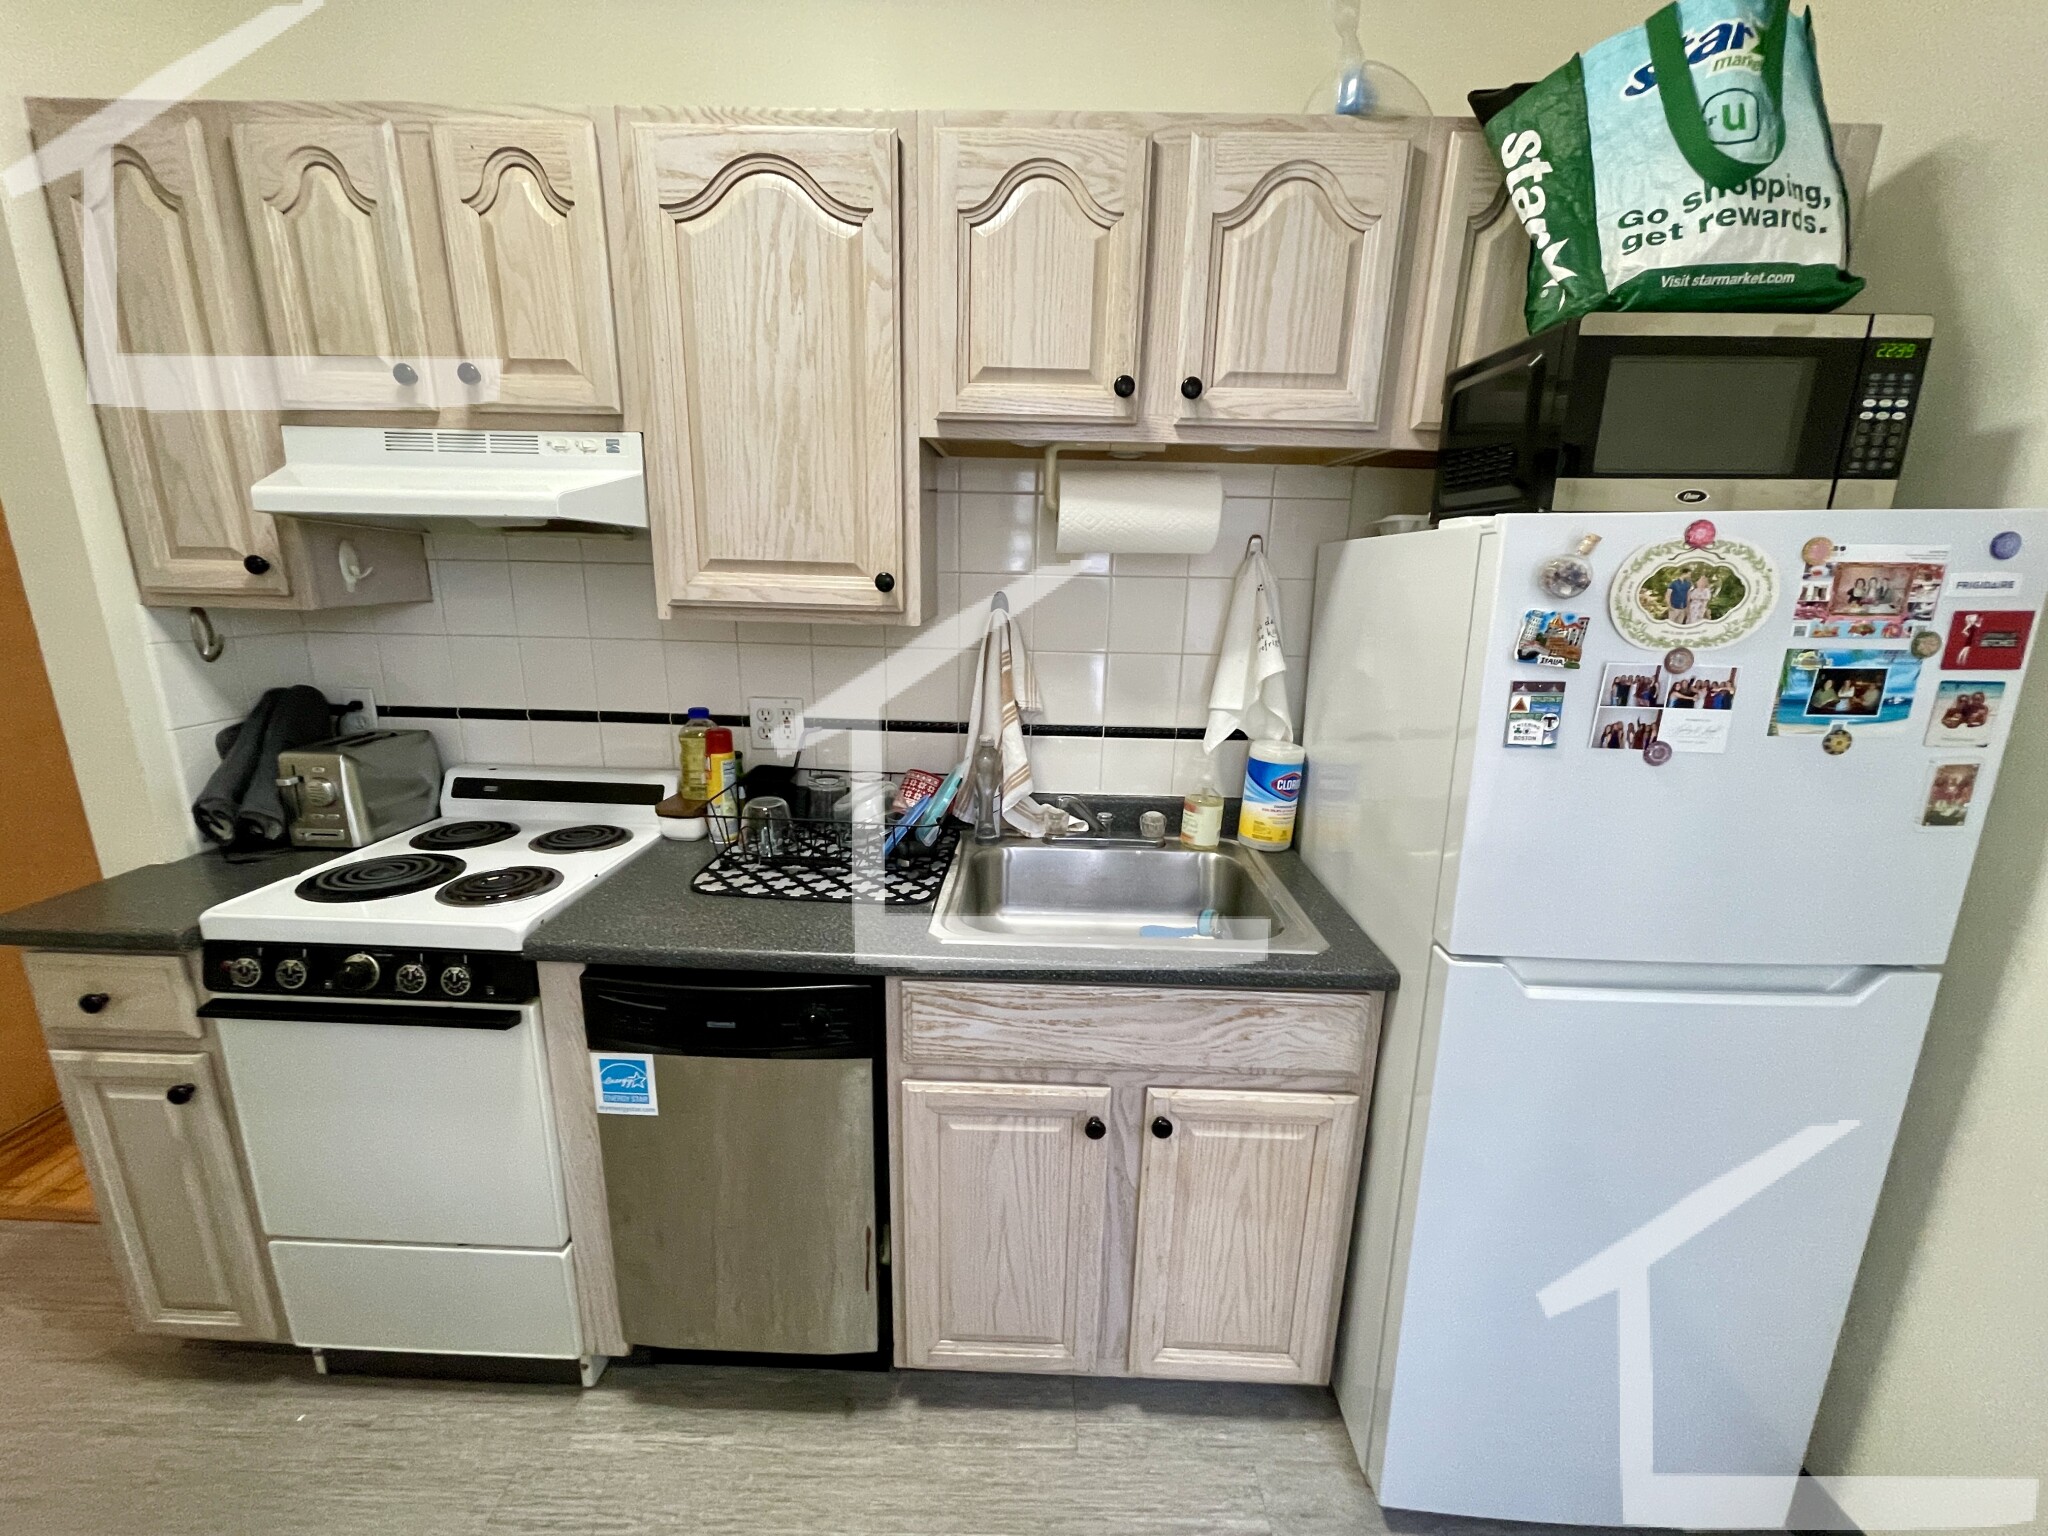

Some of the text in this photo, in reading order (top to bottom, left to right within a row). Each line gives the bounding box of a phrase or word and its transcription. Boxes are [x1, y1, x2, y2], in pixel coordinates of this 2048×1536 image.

[1617, 208, 1669, 229] Go
[1621, 206, 1828, 256] get rewards.
[1661, 272, 1795, 288] Visit starmarket.com
[1956, 581, 2015, 589] FRIGIDAIRE
